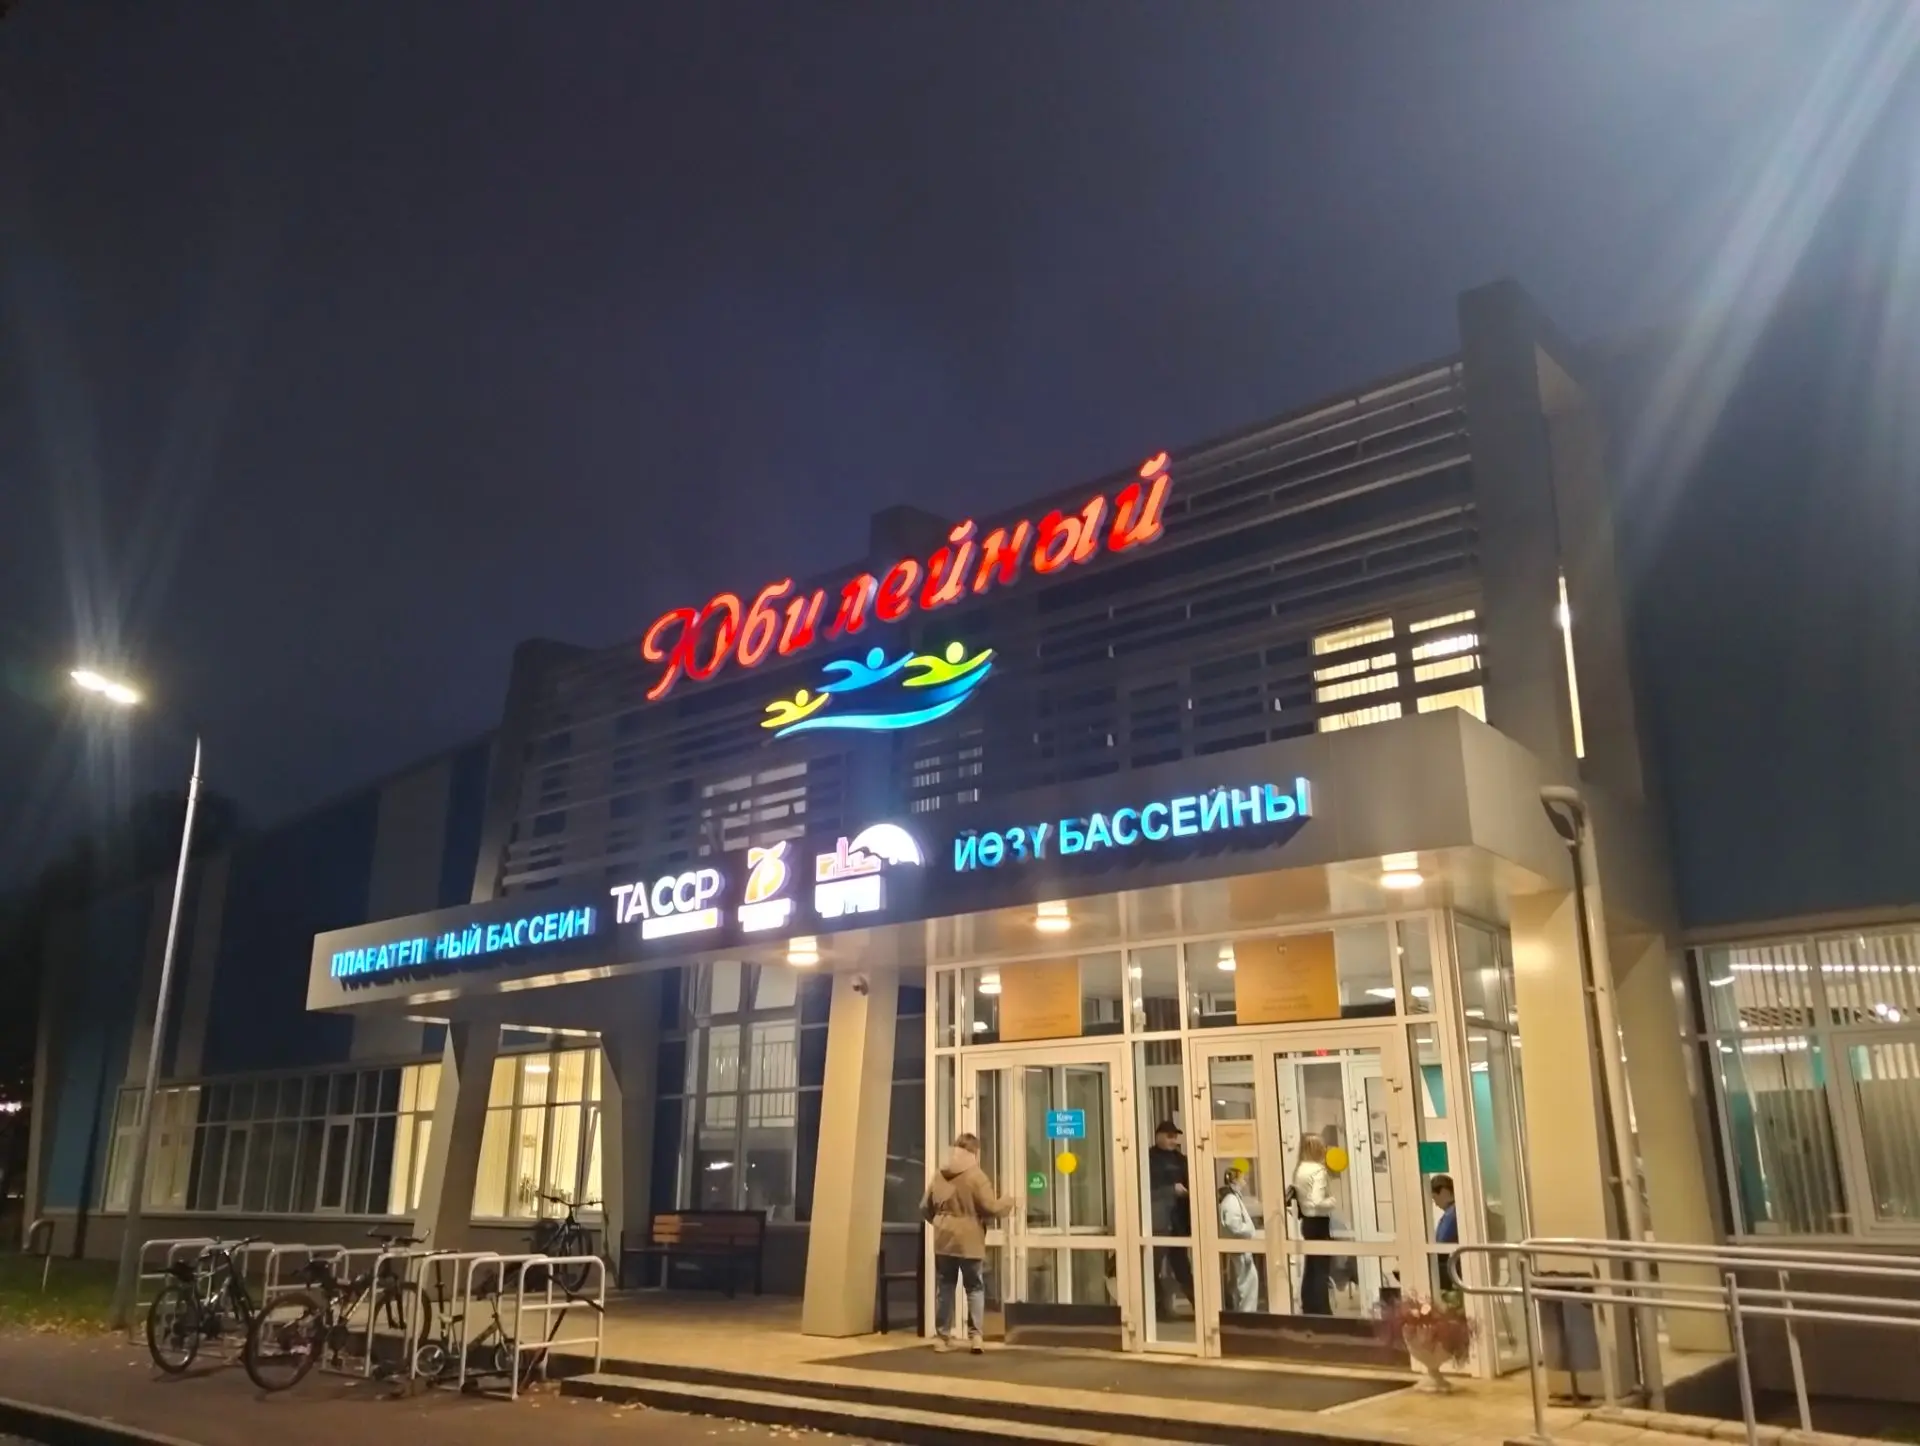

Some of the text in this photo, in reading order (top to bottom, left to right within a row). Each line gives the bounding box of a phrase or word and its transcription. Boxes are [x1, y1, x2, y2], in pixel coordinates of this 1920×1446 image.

[641, 451, 1172, 700] Юбилейный
[1058, 777, 1312, 854] БАССЕЙНЫ
[611, 868, 719, 923] ТАССР
